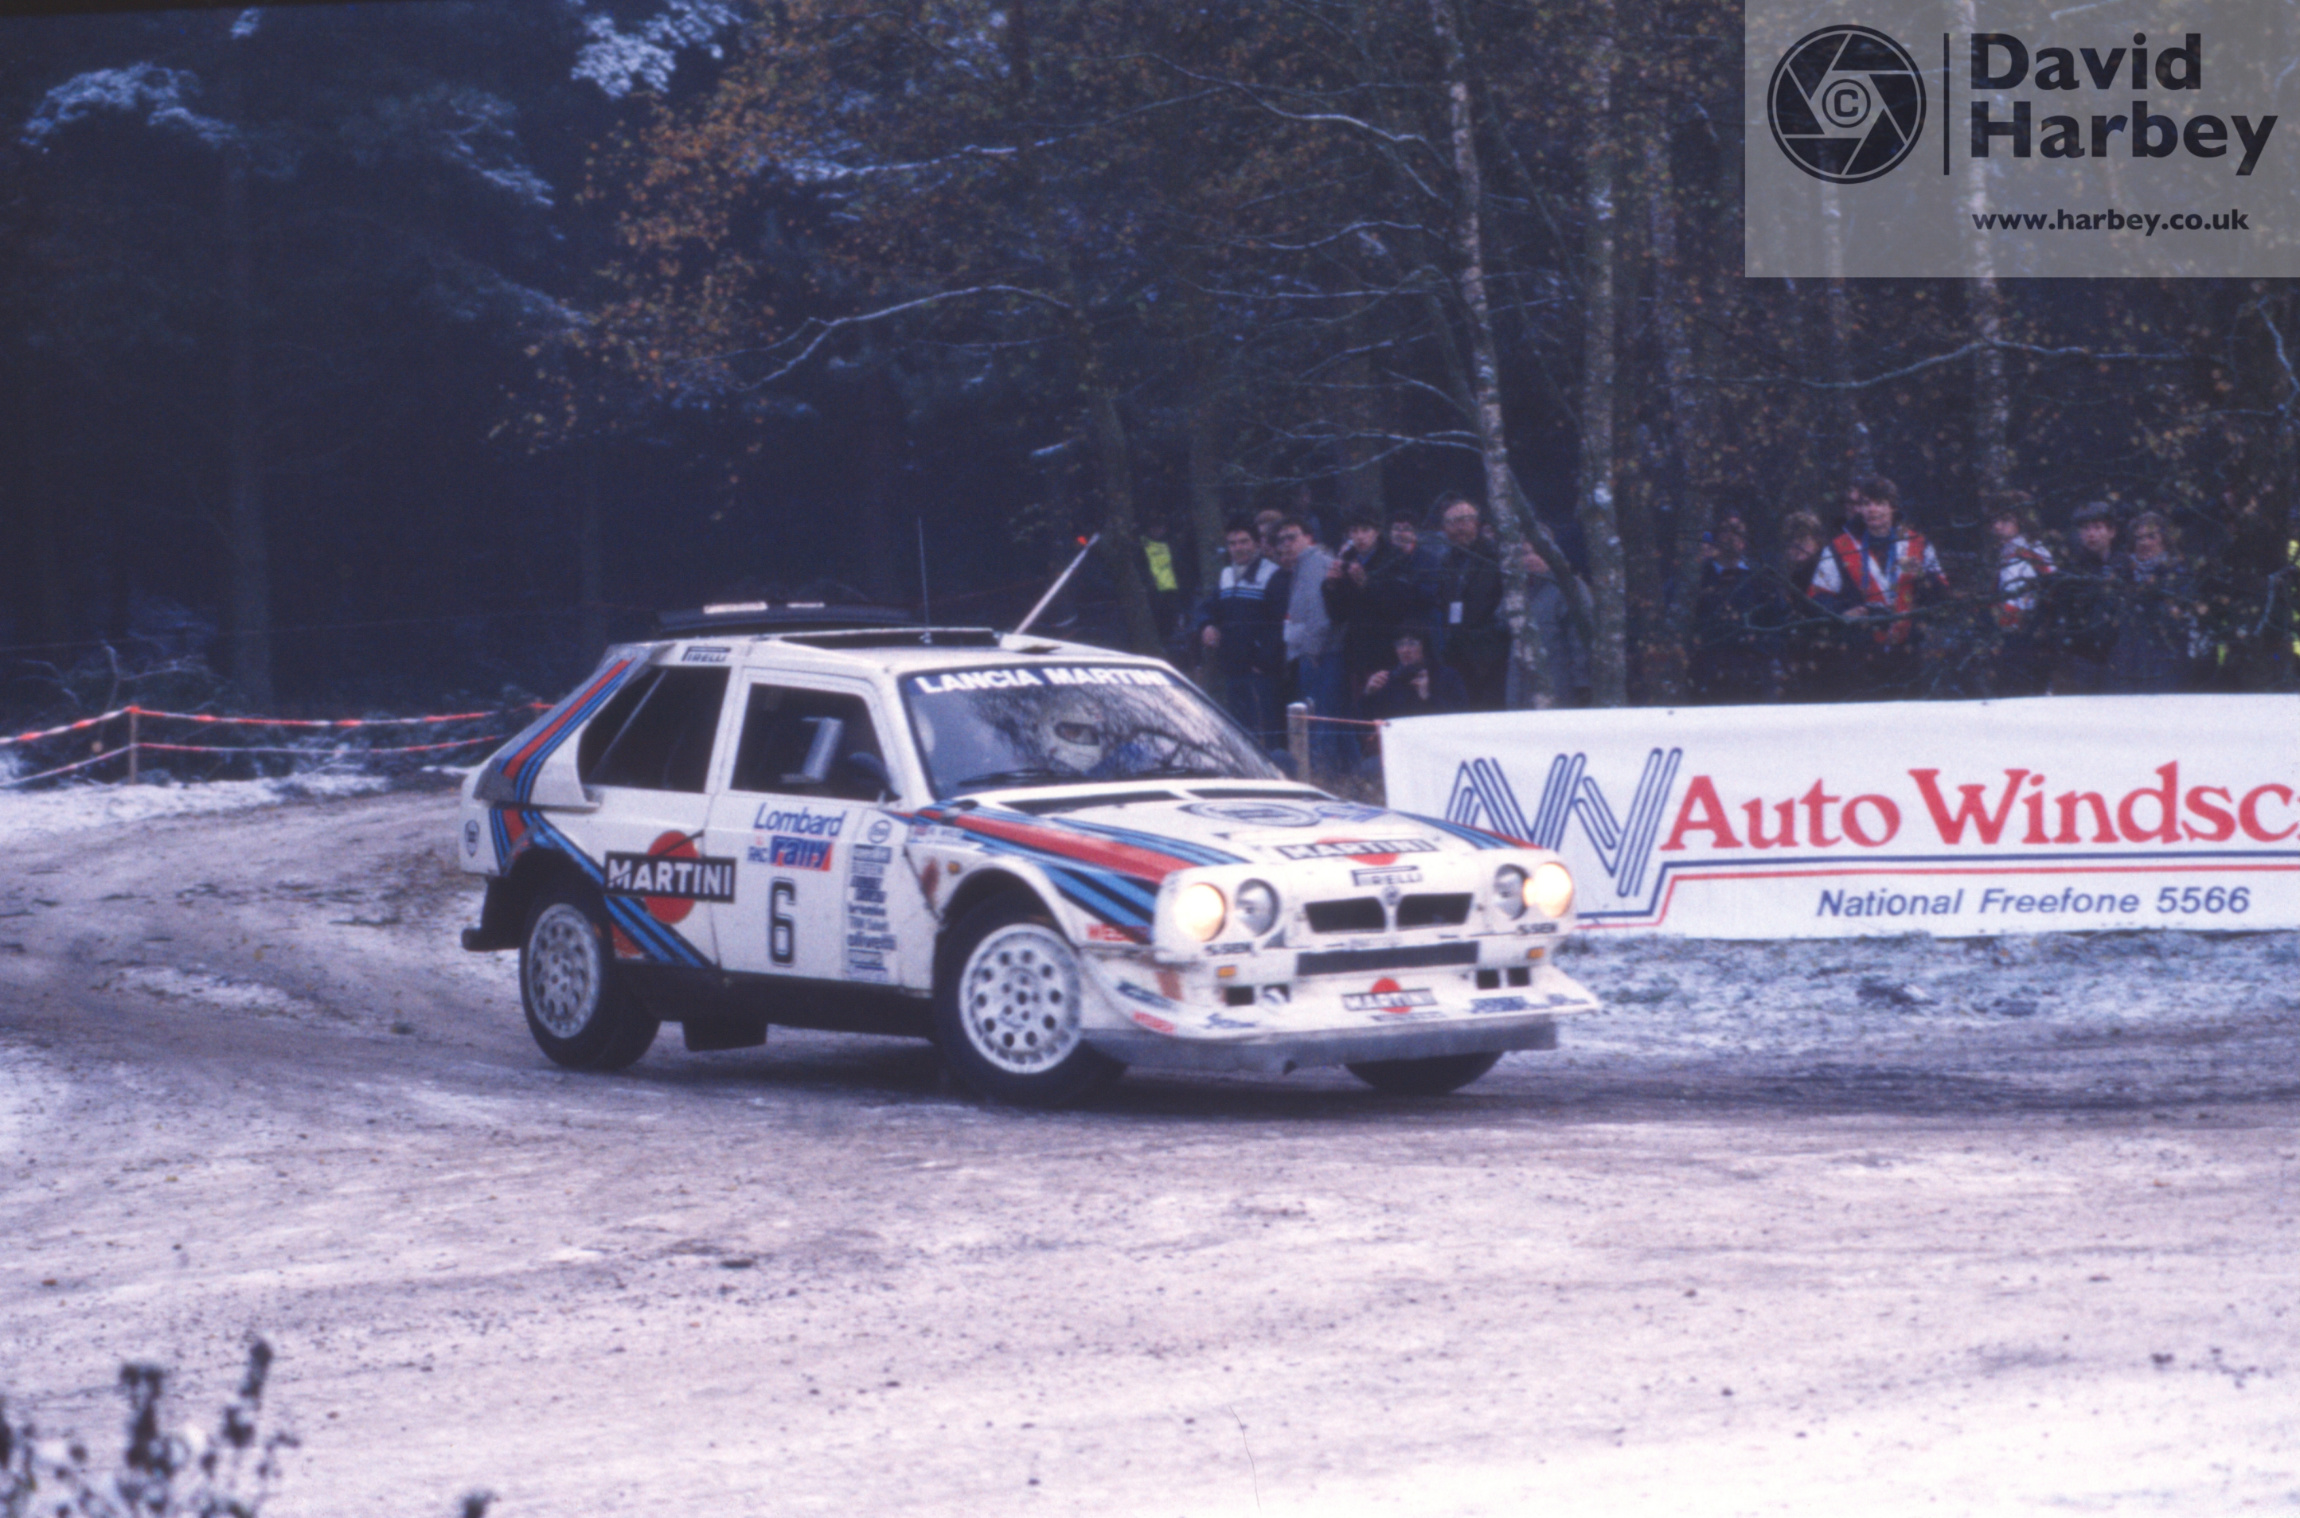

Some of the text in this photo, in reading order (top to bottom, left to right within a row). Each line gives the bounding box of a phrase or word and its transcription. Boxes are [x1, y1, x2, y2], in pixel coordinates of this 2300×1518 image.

[915, 667, 1173, 694] LANCIA MARTINI
[753, 802, 848, 838] Lombard
[1659, 760, 2300, 852] Auto Windsc
[607, 859, 733, 896] MARTINI
[1816, 886, 2251, 917] National Freefone 5566
[770, 877, 796, 966] 6
